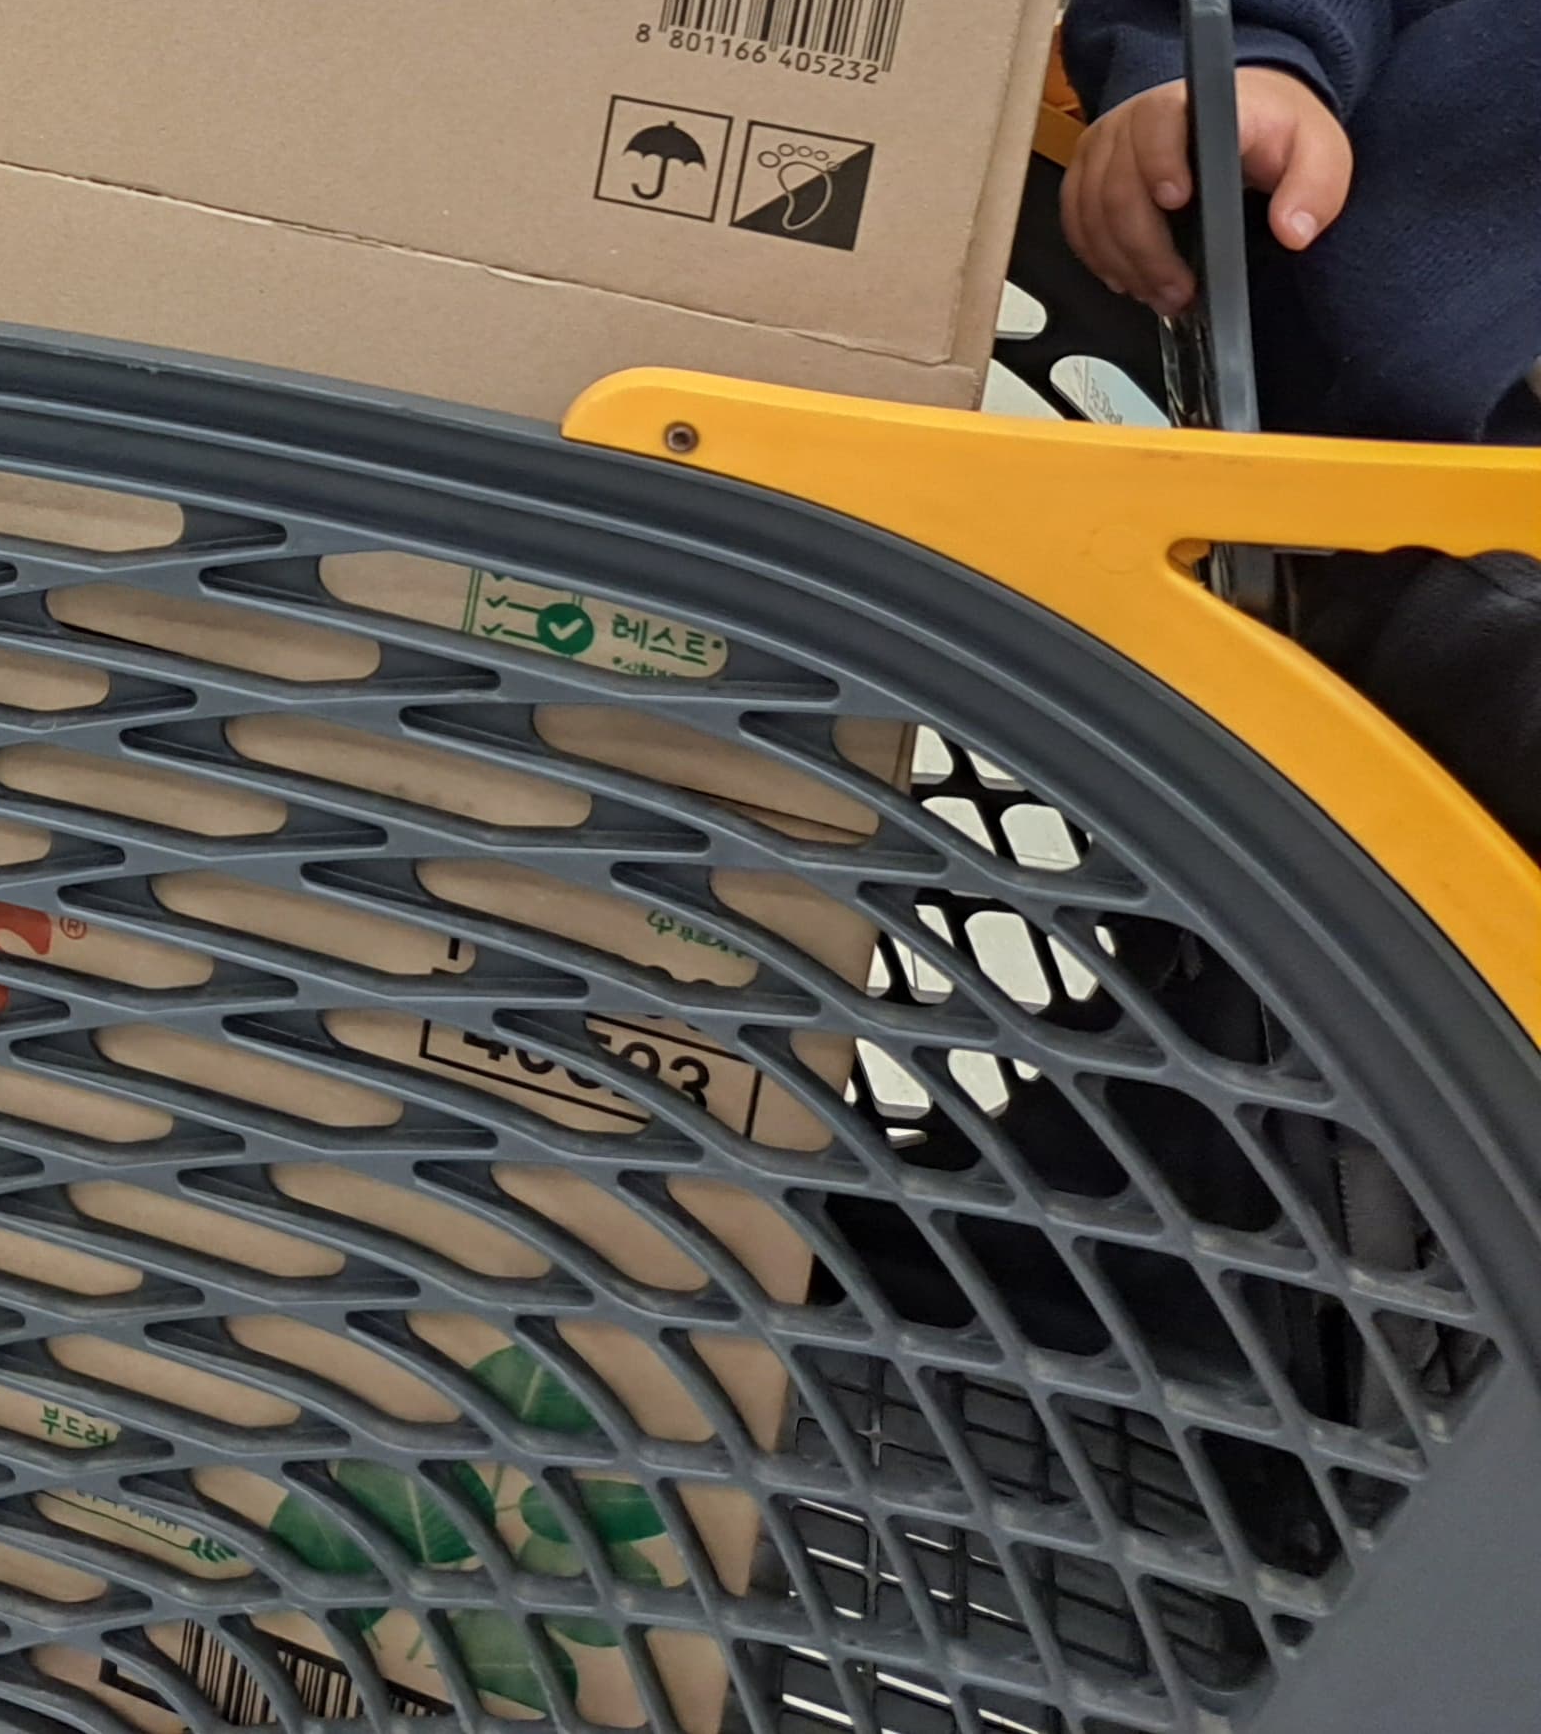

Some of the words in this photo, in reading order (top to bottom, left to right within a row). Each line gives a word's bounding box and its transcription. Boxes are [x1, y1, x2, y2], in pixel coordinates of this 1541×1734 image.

[634, 22, 652, 44] 8
[668, 29, 768, 64] 801166
[778, 48, 880, 85] 405232
